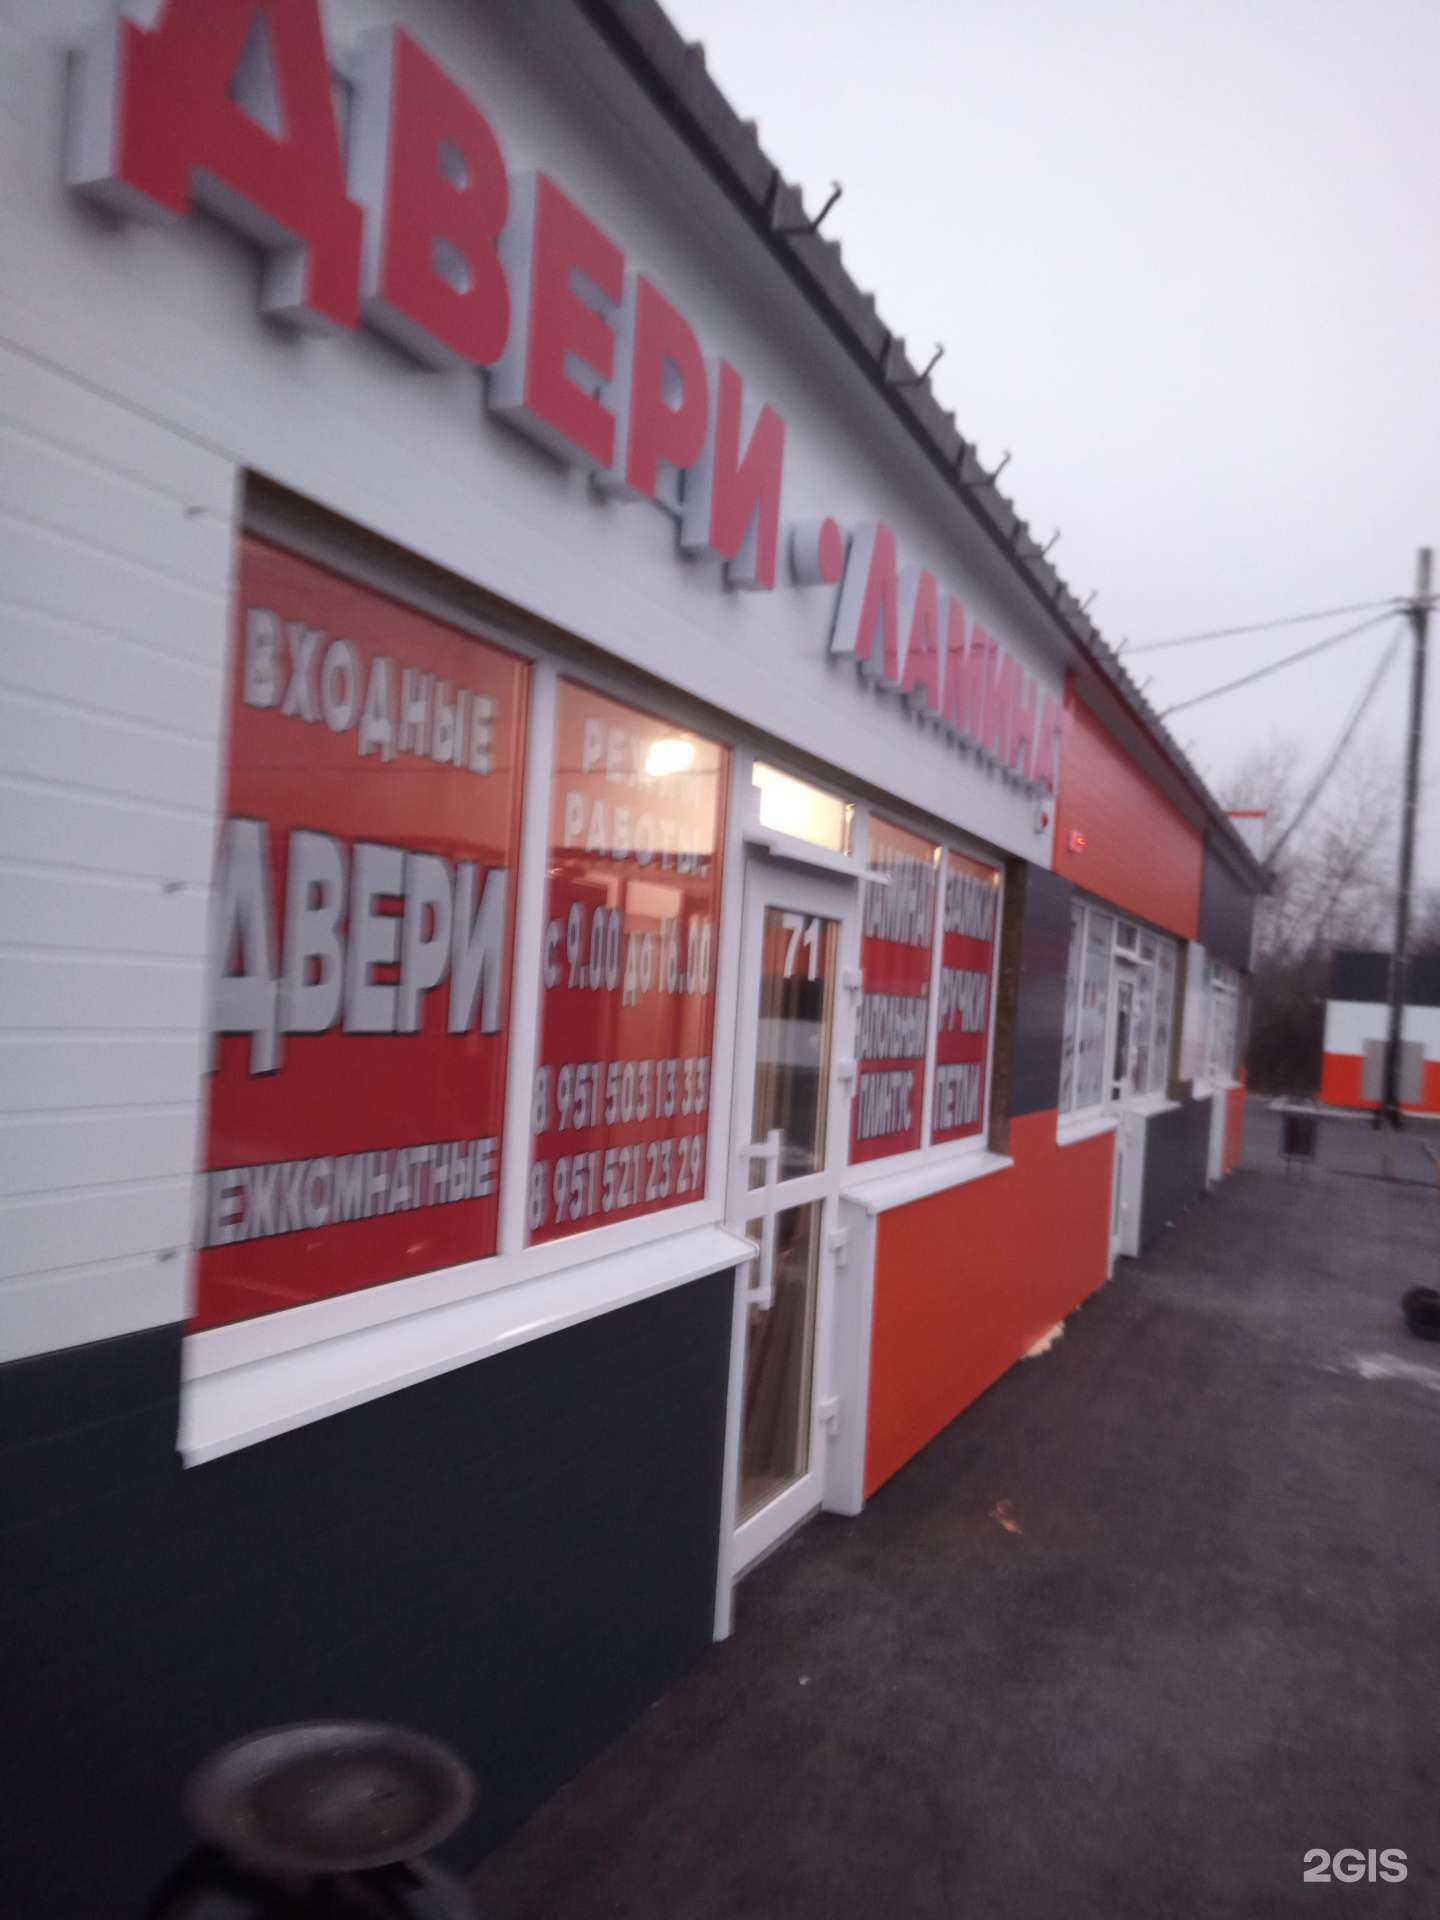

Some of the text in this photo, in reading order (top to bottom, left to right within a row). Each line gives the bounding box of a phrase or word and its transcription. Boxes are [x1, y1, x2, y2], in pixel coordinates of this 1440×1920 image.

[110, 0, 786, 592] ДВЕРИ
[244, 606, 496, 776] ВХОДНЫЕ
[202, 814, 509, 1079] ДВЕРИ
[567, 901, 623, 992] 9.00
[782, 912, 821, 983] 71
[557, 1061, 601, 1132] 951
[605, 1059, 651, 1126] 503
[192, 1136, 498, 1250] ЕЖКОМНАТНЫЕ
[553, 1151, 600, 1225] 951
[603, 1145, 642, 1213] 521
[645, 1138, 673, 1200] 23
